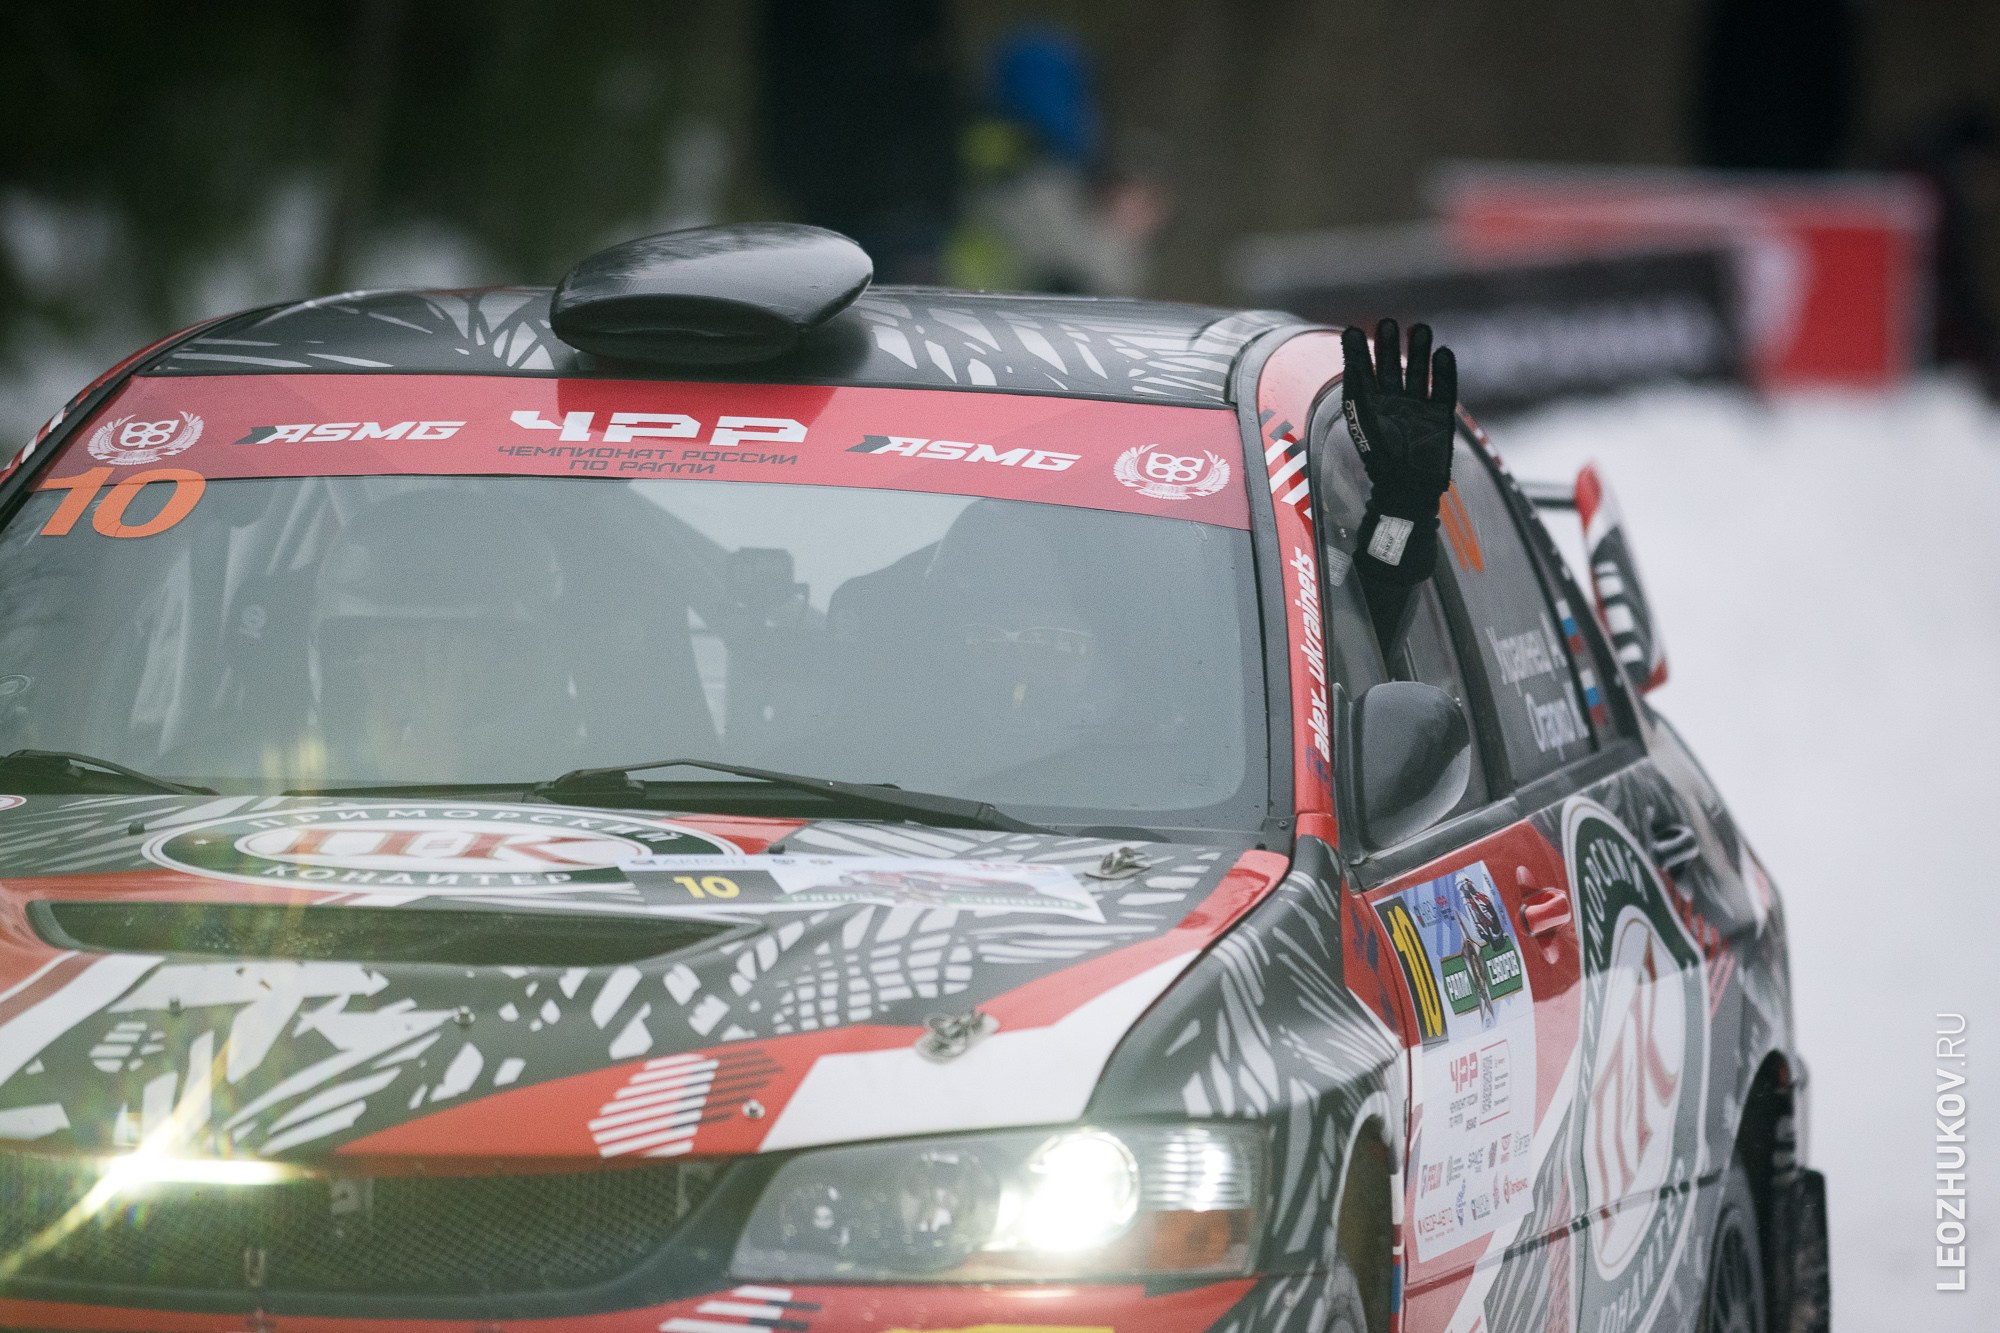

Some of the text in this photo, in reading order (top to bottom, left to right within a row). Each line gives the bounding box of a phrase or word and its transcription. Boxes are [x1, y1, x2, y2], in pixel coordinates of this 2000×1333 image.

[256, 421, 467, 444] ASMG
[510, 411, 808, 446] ЧРР
[498, 446, 798, 465] ЧЕМПИОНАТ РОССИИ
[570, 459, 716, 474] ПО РАЛЛИ
[869, 436, 1082, 471] ASMG
[41, 466, 206, 538] 10
[1291, 546, 1330, 763] alex_ukrainets
[249, 808, 684, 842] ПРИМОРСКИЙ
[261, 865, 573, 887] КОНДИТЕР
[673, 875, 740, 899] 10
[1387, 905, 1442, 1038] 10
